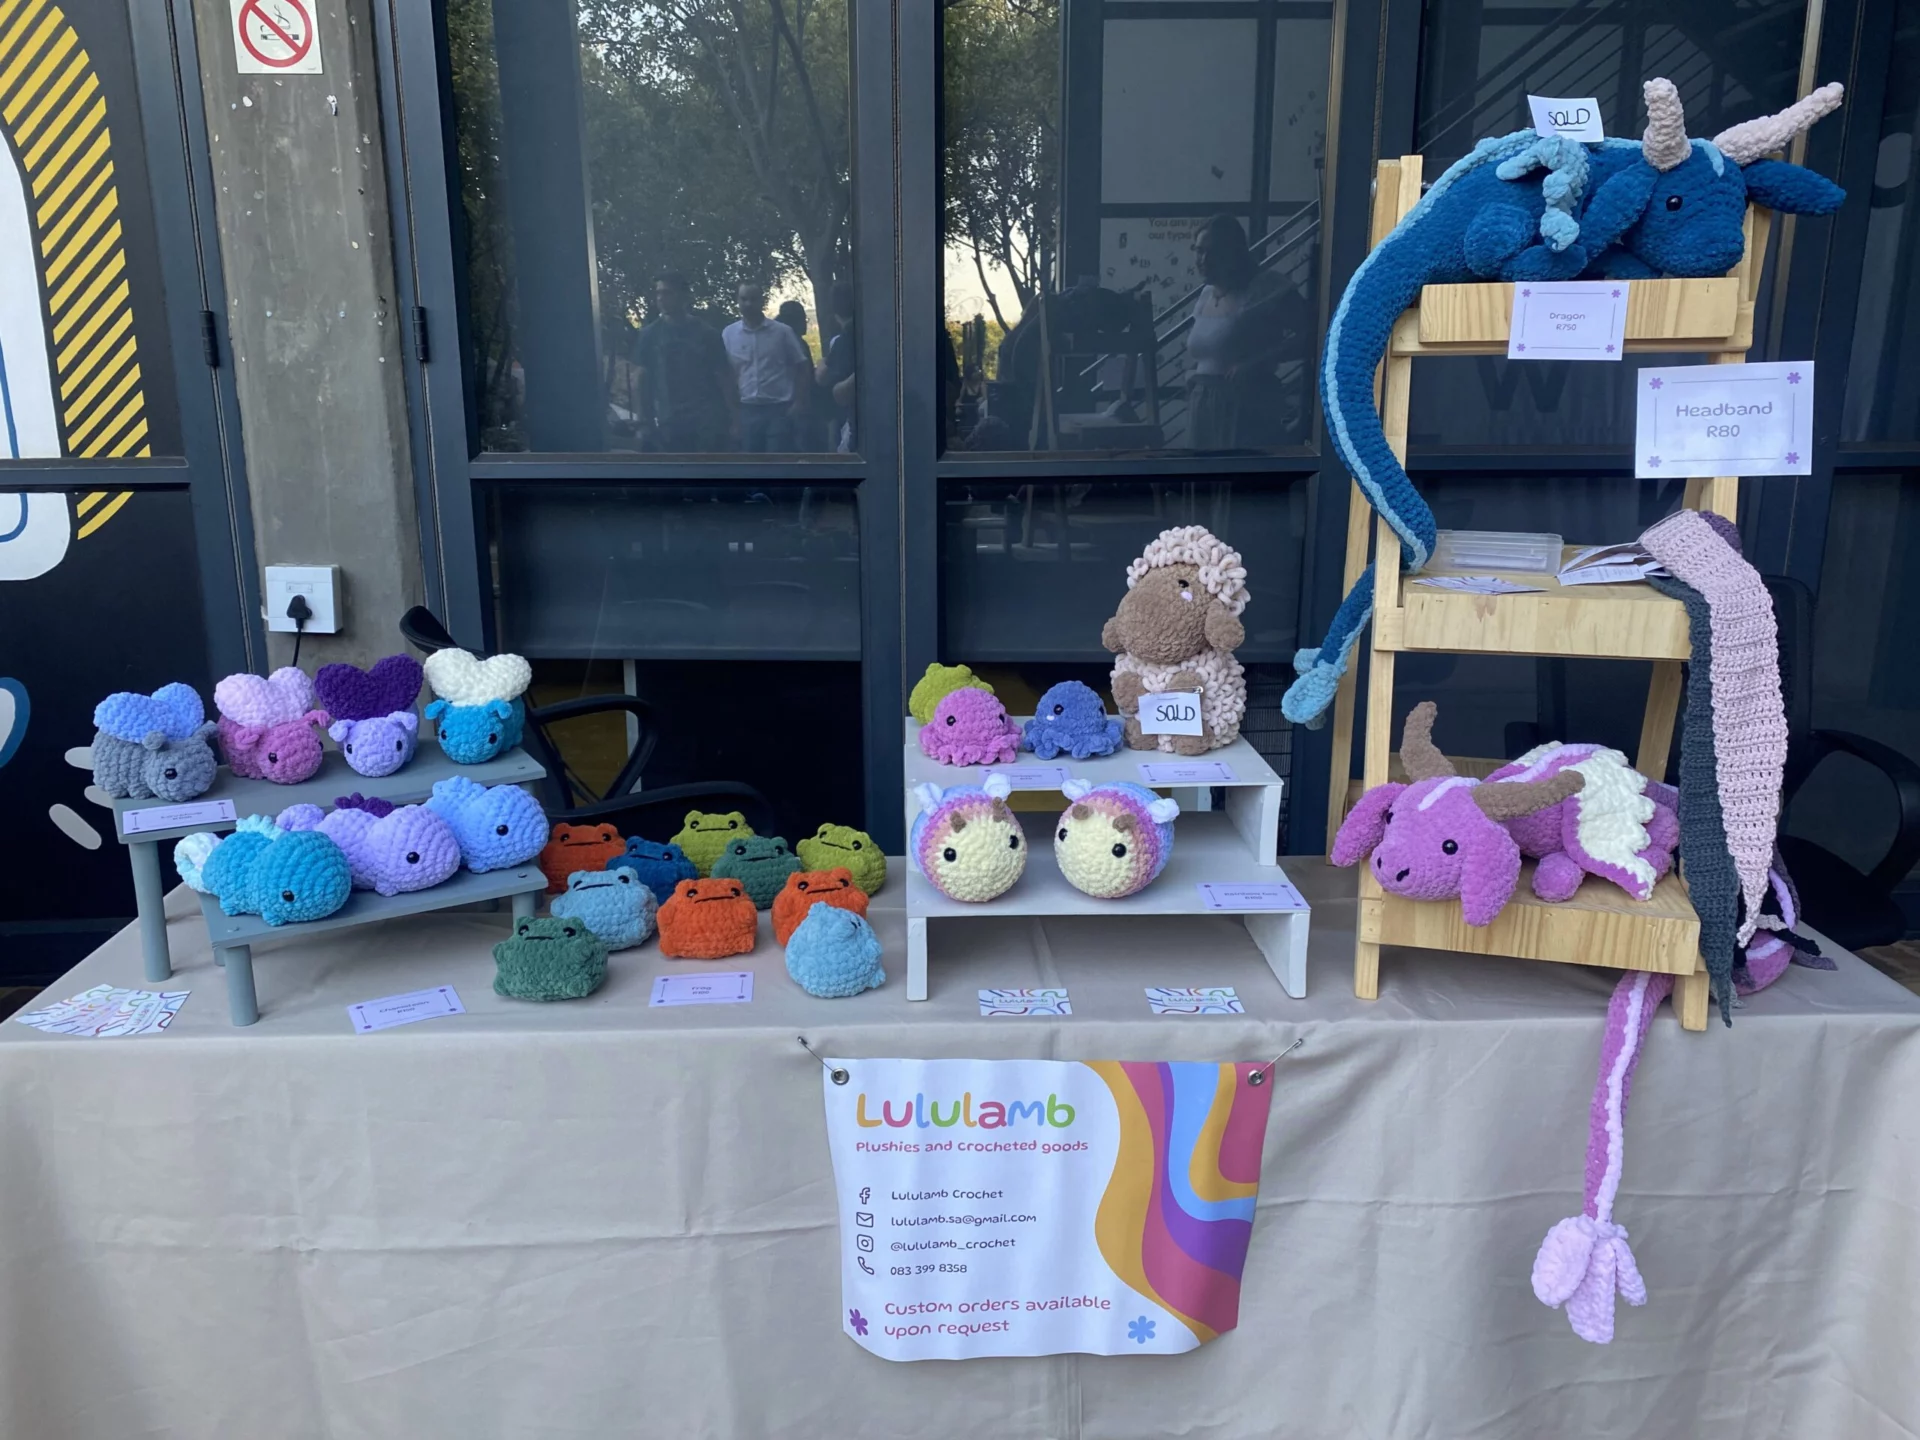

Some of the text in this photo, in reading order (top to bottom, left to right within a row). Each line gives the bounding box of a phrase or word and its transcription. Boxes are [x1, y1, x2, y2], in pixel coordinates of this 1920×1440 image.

[1548, 108, 1591, 127] SOLD
[1549, 312, 1586, 322] Dragon
[1676, 401, 1773, 417] Headband
[1706, 424, 1741, 438] R80
[1155, 704, 1196, 722] SOLD
[856, 1092, 1076, 1129] Lululamb
[856, 1140, 1088, 1154] Plushies and crocheted goods
[891, 1189, 1004, 1200] Lululamb Crochet
[891, 1214, 1037, 1226] lululamb.sa@gmail.com
[890, 1238, 1016, 1251] @lululamb_crochet
[890, 1263, 967, 1275] 083 399 8358
[885, 1295, 1112, 1315] Custom orders available
[885, 1319, 1010, 1340] upon request
